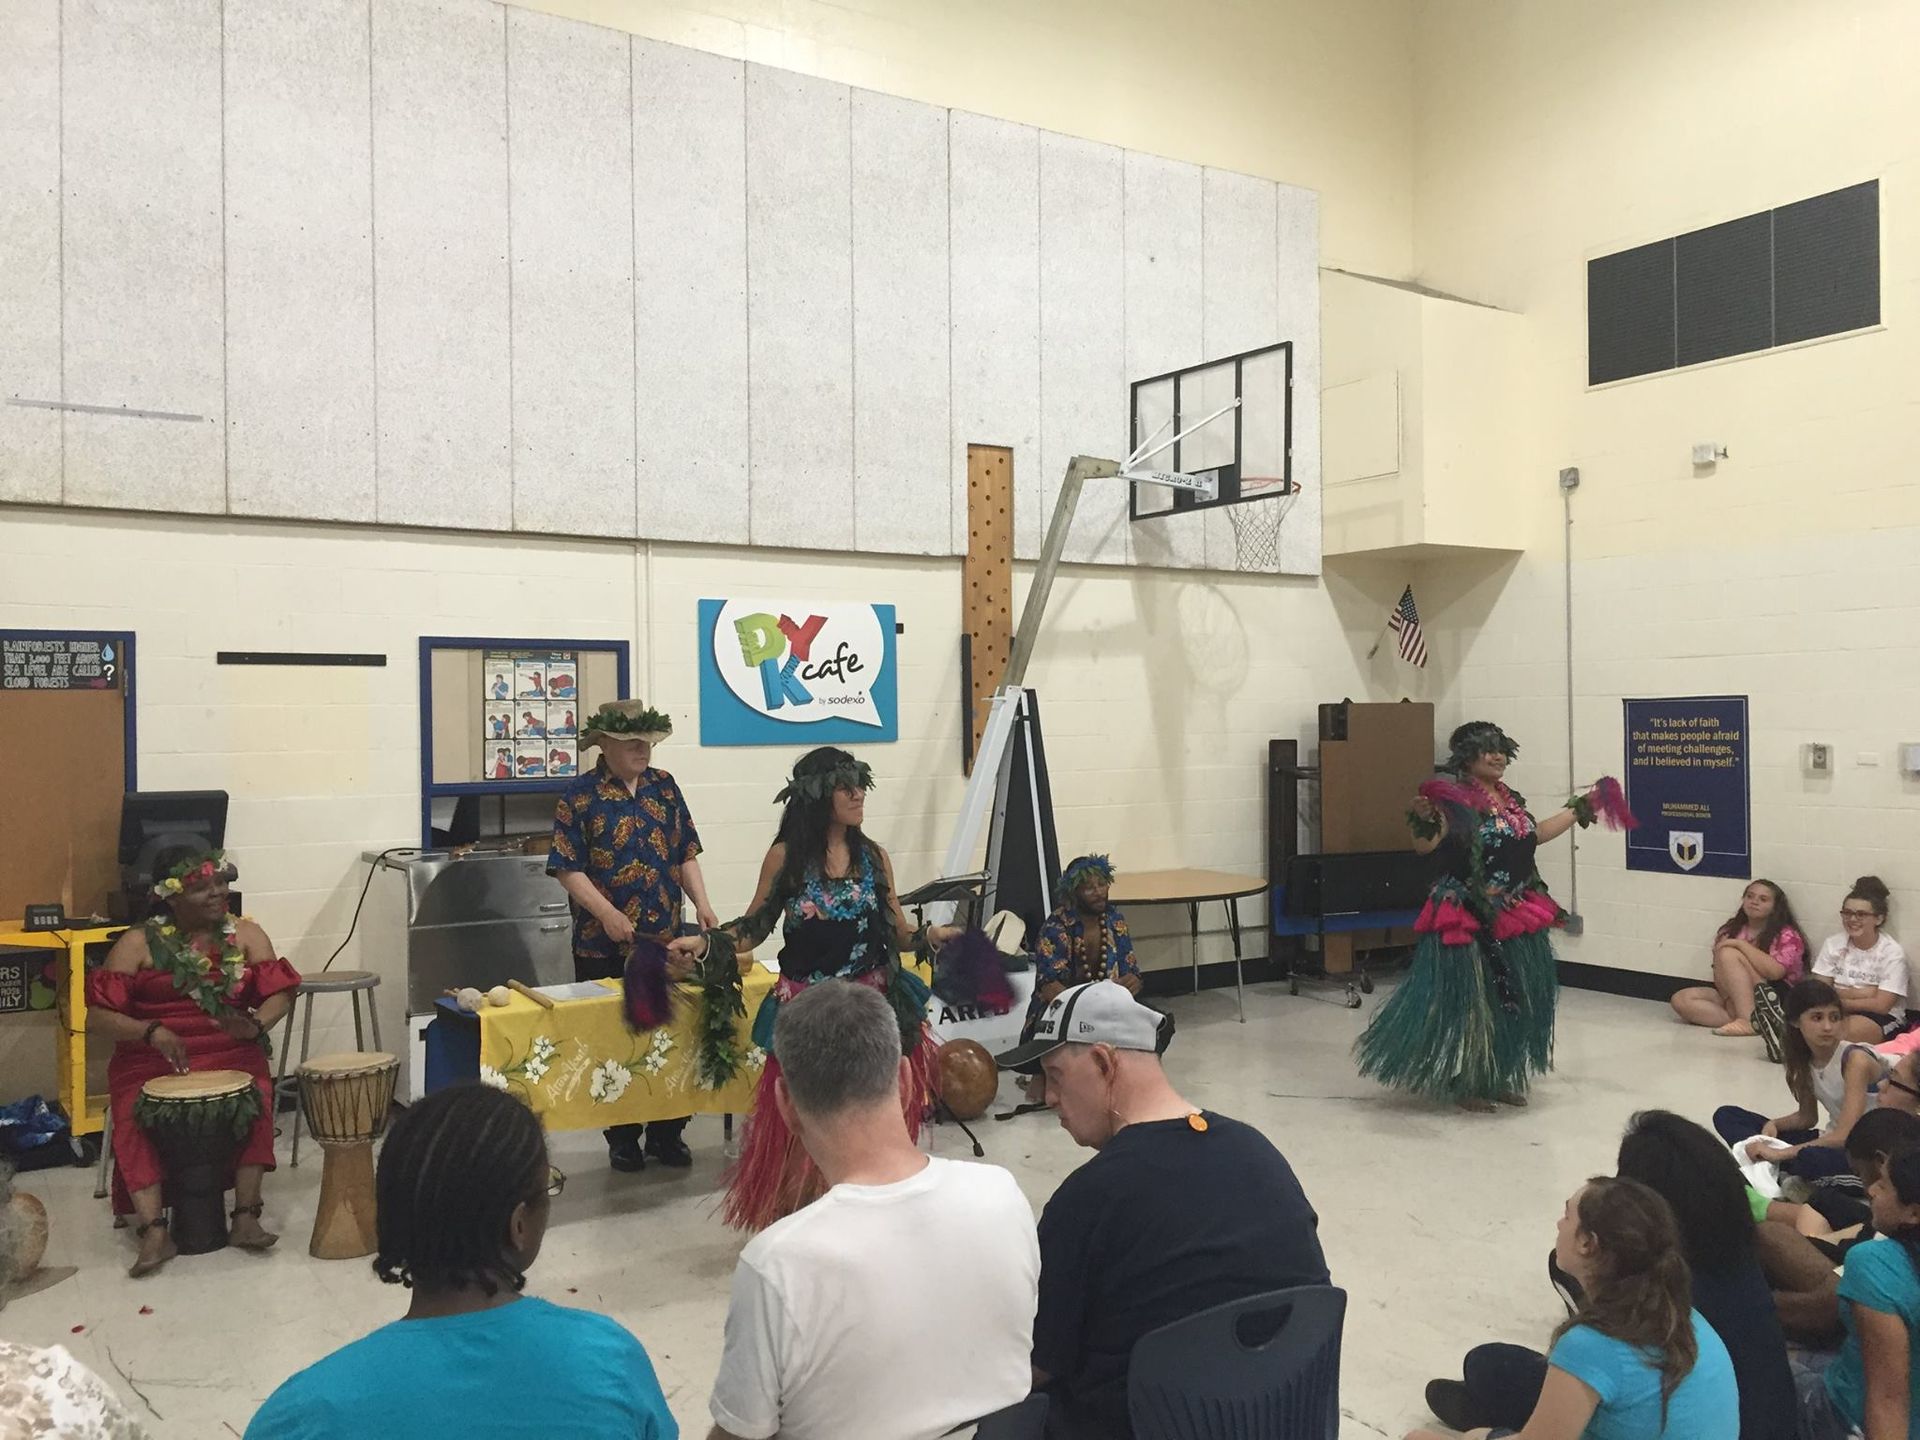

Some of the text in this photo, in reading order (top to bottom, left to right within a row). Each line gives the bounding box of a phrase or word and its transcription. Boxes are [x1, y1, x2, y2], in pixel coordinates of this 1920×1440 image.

[3, 640, 66, 653] RAINFORESTS
[4, 653, 26, 664] THAN
[53, 653, 72, 664] FEET
[75, 653, 101, 665] ABOVE
[801, 641, 865, 683] cafe
[4, 664, 21, 676] SEA
[24, 664, 48, 676] LEVEL
[51, 664, 69, 676] ARE
[72, 664, 102, 677] CALLED
[4, 676, 70, 689] CLOUD FORESTS
[818, 691, 866, 706] by sodexo
[1669, 717, 1687, 728] lack
[1688, 717, 1699, 728] of
[1699, 716, 1720, 728] faith
[1633, 730, 1740, 743] that makes people afraid
[1637, 743, 1735, 756] of meeting challenges,
[1633, 756, 1649, 766] and
[1655, 756, 1692, 767] believed
[1693, 756, 1702, 767] in
